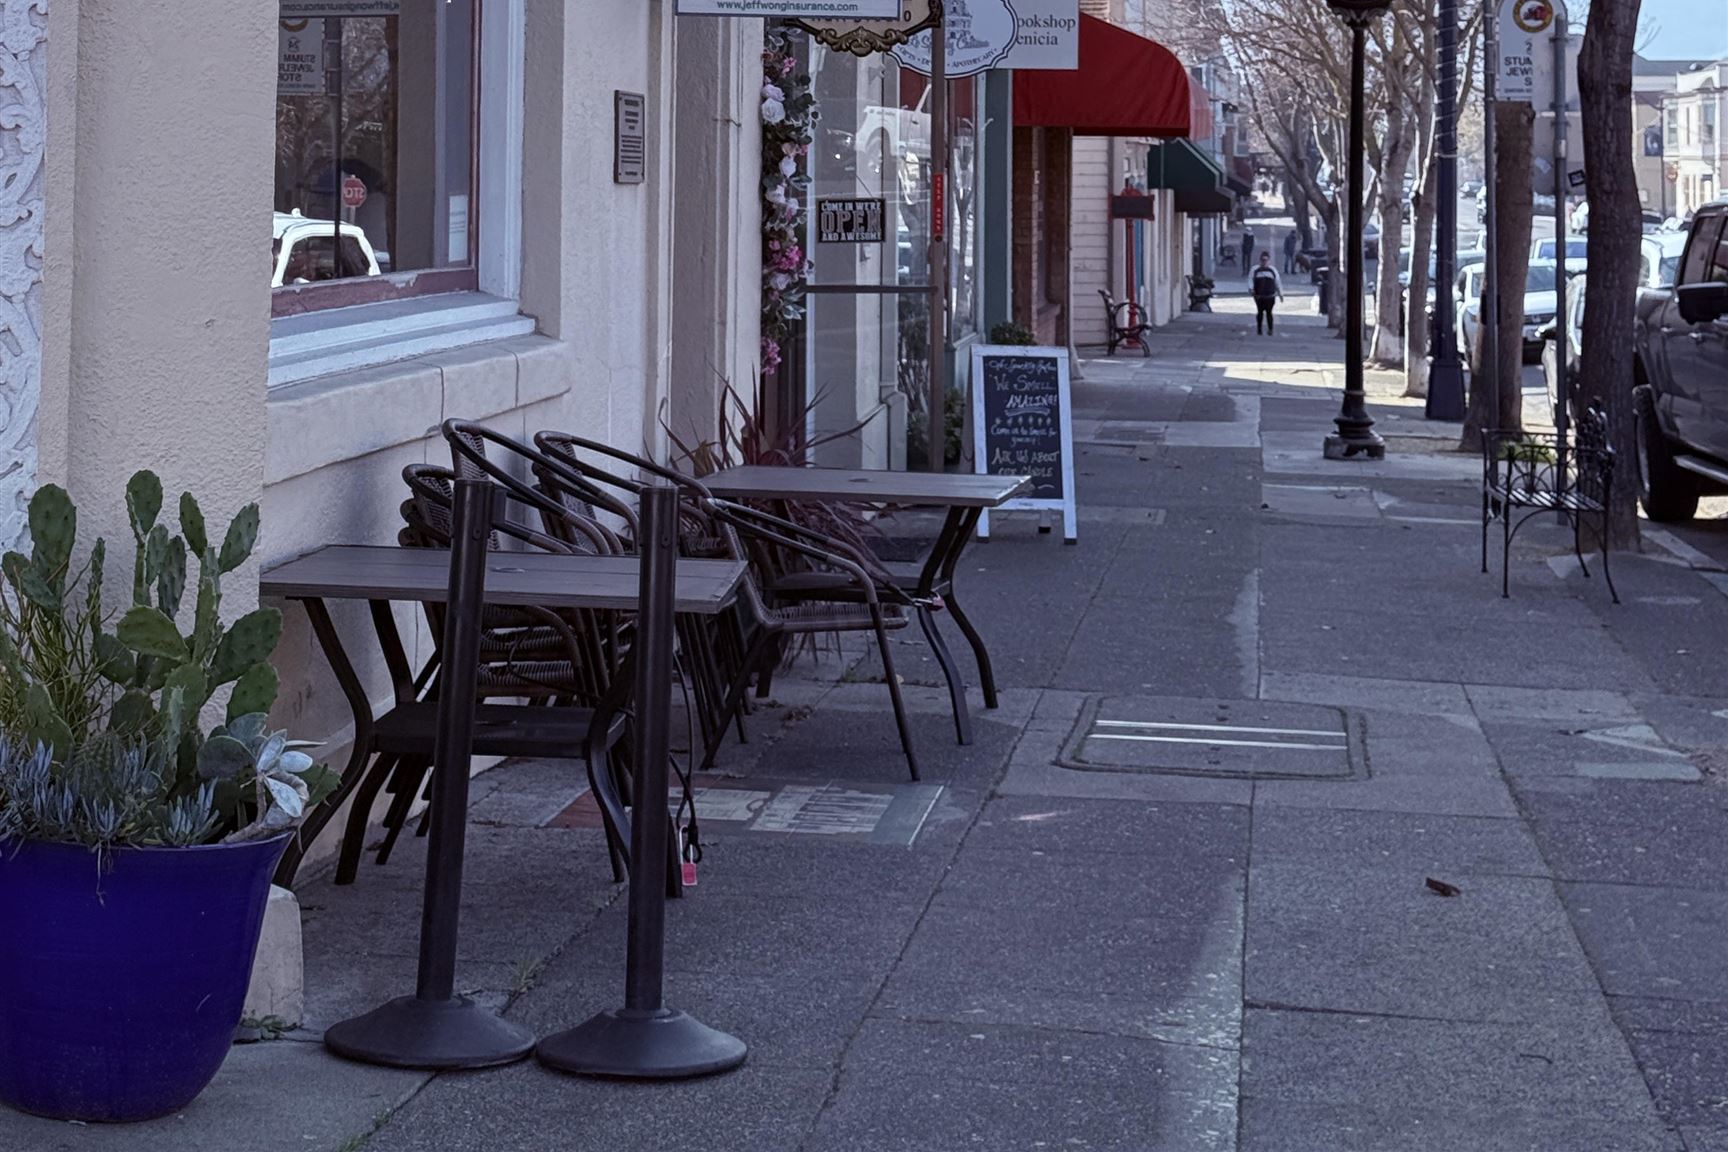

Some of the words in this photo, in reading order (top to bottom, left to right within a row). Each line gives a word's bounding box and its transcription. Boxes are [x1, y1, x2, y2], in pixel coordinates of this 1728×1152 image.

[717, 0, 859, 12] www.jeffwonginsurance.com
[1018, 14, 1076, 32] ookshop
[1017, 32, 1058, 45] enicia
[821, 201, 843, 211] COME
[845, 202, 854, 211] IN
[821, 211, 881, 233] OPEN
[822, 232, 839, 241] AND
[841, 232, 881, 241] AWESOME
